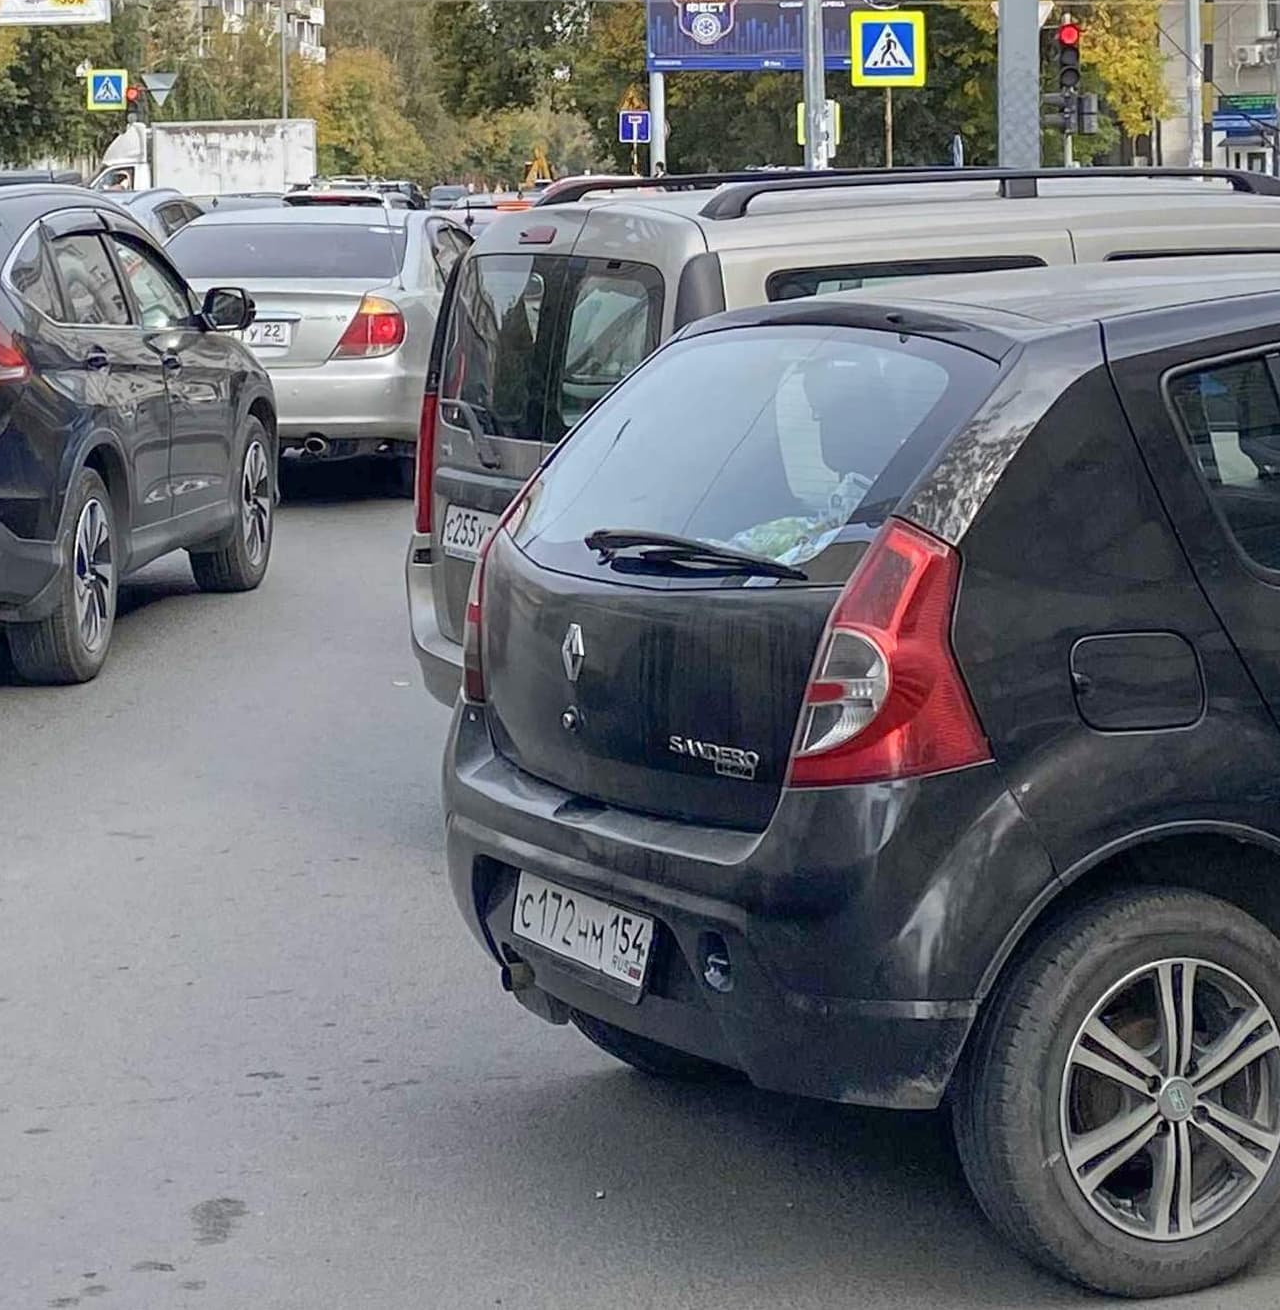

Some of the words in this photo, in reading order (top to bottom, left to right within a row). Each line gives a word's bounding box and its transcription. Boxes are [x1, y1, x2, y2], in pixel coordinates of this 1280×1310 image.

[686, 1, 726, 13] ФЕСТ
[263, 323, 281, 338] 22
[668, 735, 760, 768] SANDERO
[610, 913, 645, 963] 154
